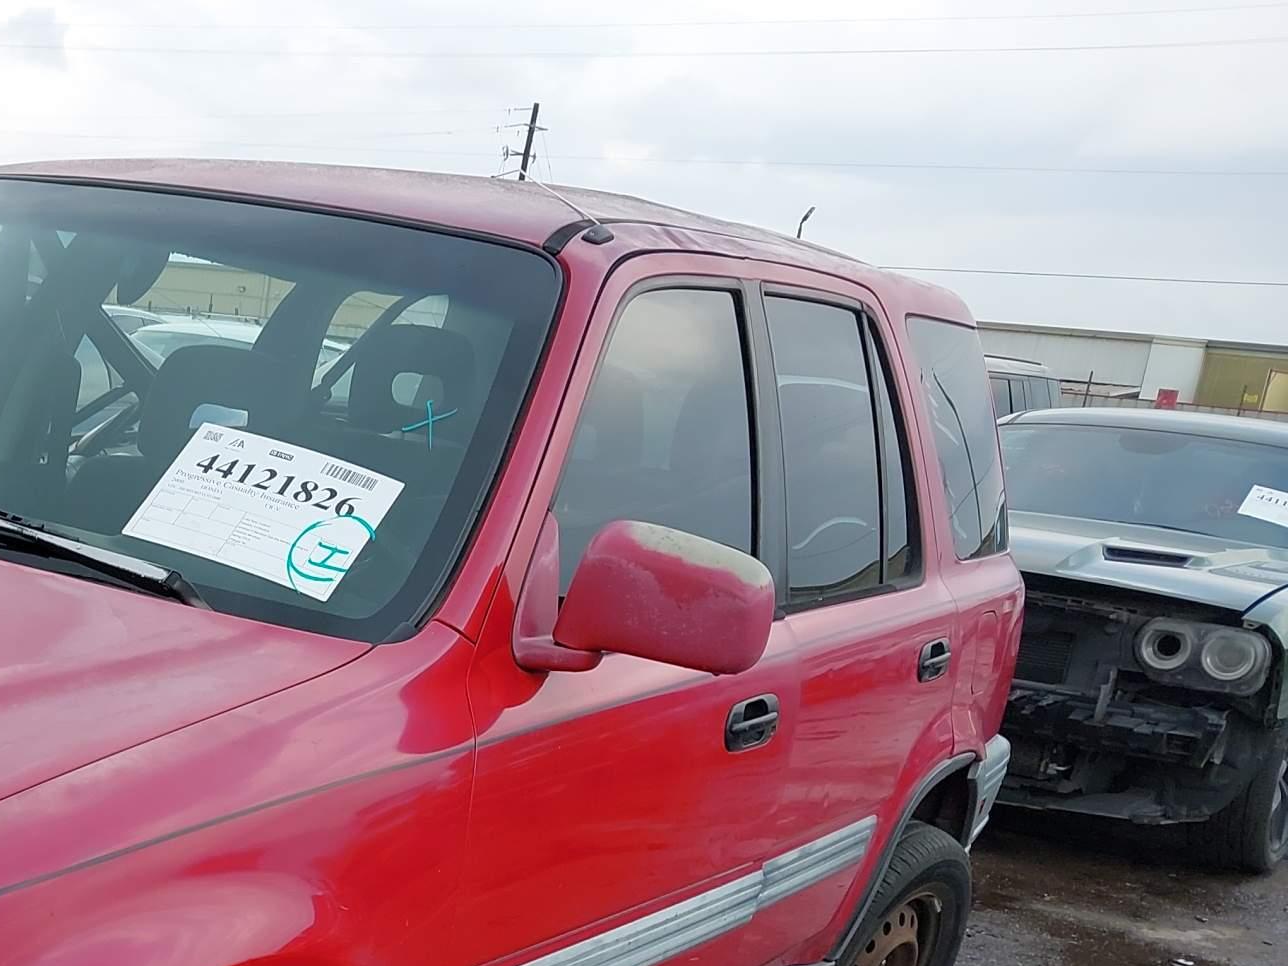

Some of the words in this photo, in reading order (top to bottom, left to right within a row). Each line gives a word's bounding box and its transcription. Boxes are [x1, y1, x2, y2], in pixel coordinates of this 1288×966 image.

[175, 468, 222, 486] Progressive
[223, 480, 257, 497] Casualty
[259, 491, 301, 511] Insurance
[196, 453, 362, 518] 44121826
